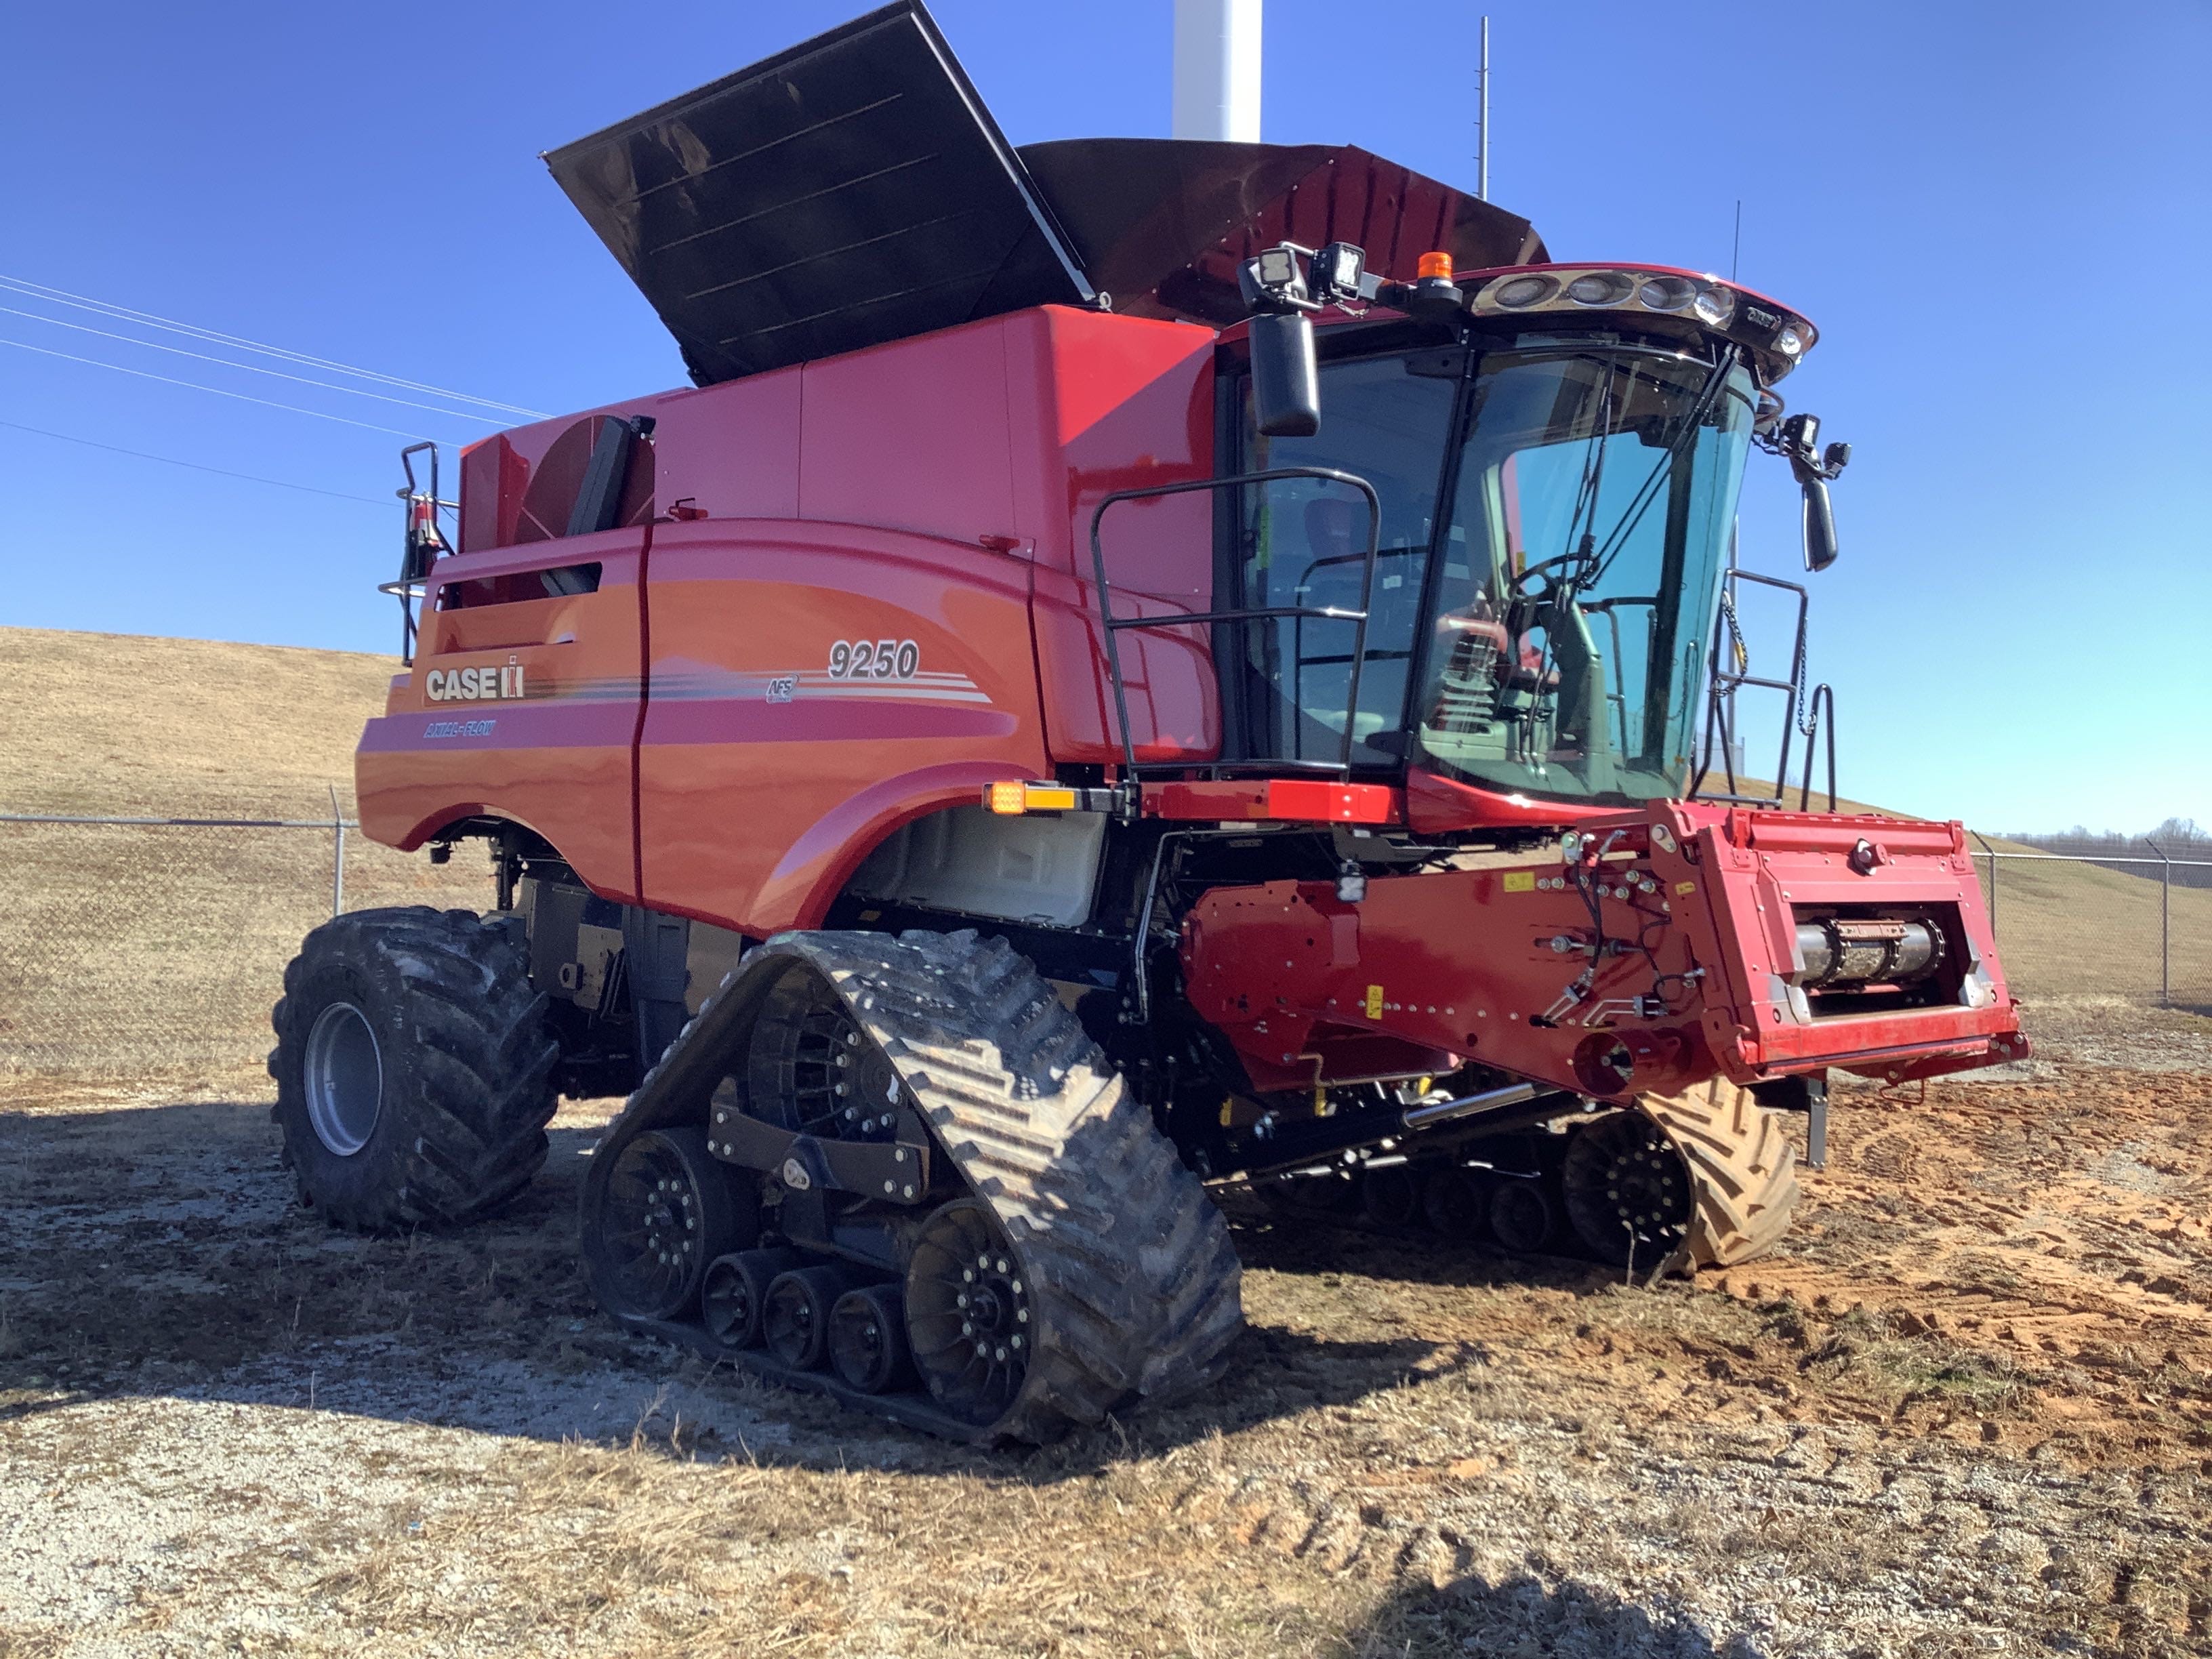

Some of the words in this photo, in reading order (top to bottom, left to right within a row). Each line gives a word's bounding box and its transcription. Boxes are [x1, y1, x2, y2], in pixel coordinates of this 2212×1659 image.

[829, 640, 919, 679] 9250
[426, 668, 497, 701] CASE
[767, 679, 792, 695] AFS
[424, 720, 496, 737] AXIAL-FLOW
